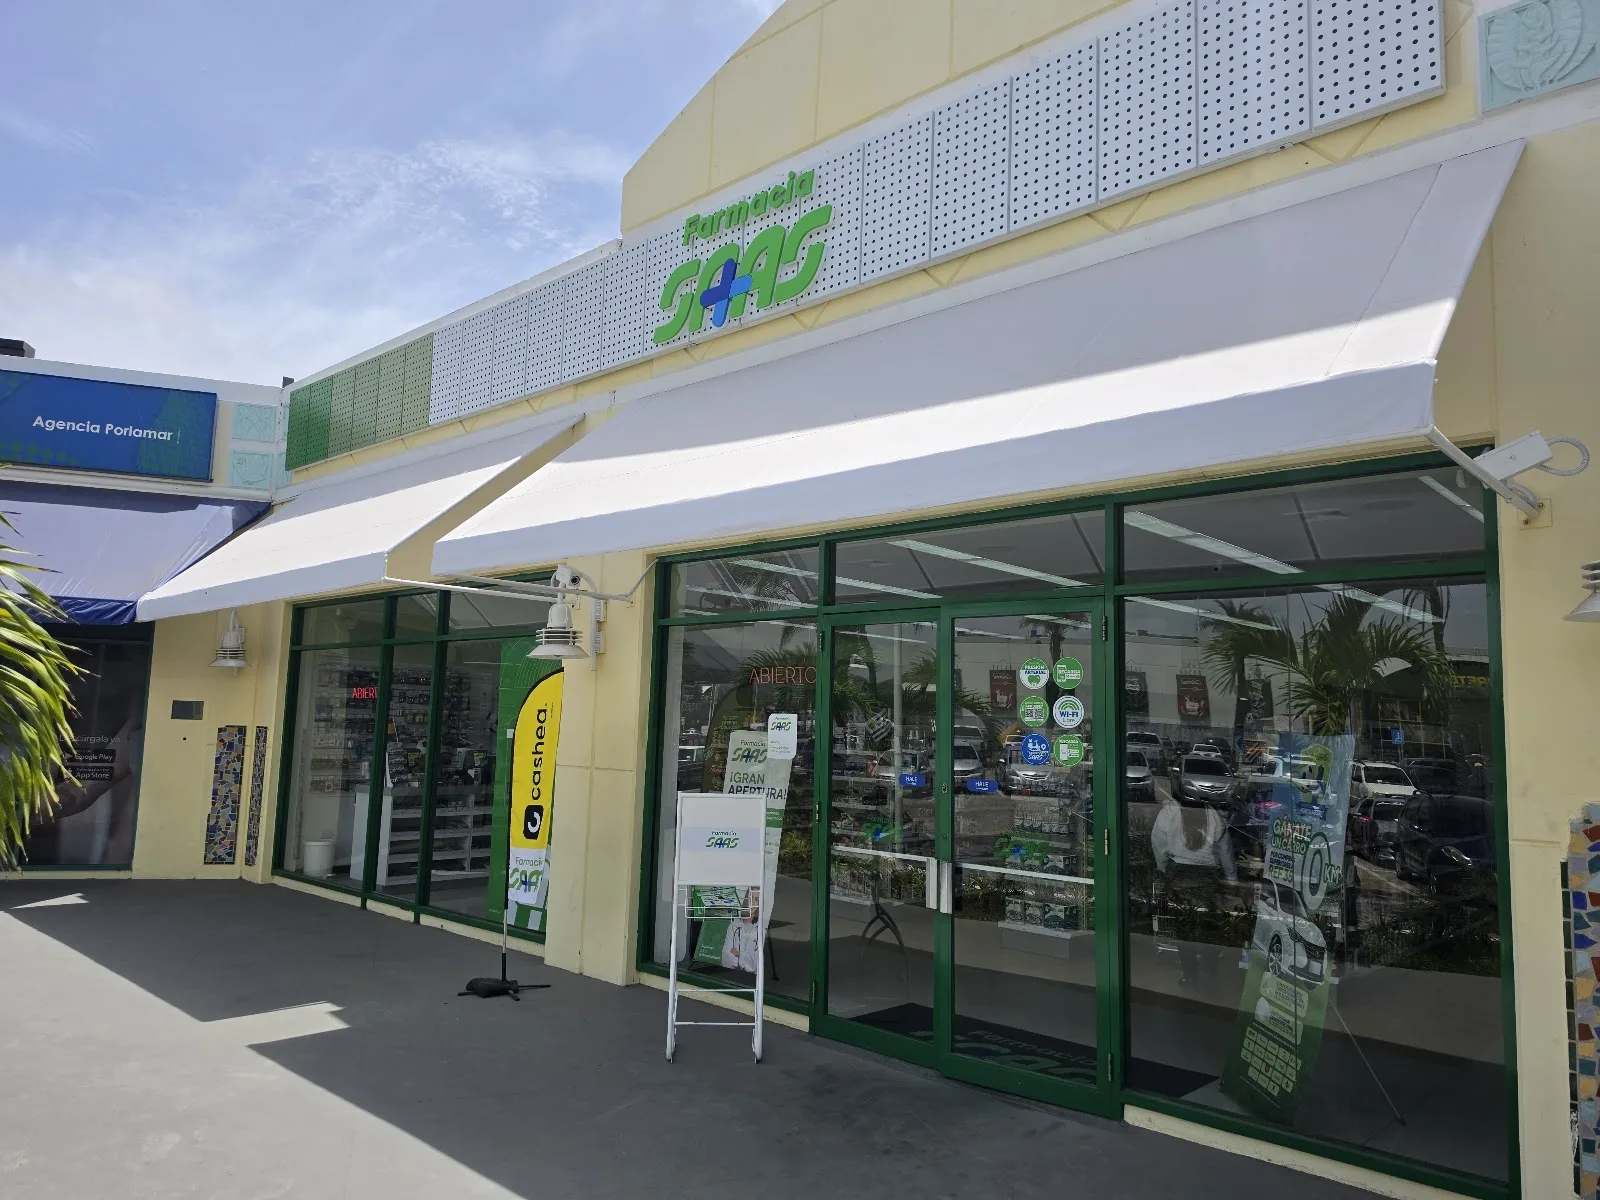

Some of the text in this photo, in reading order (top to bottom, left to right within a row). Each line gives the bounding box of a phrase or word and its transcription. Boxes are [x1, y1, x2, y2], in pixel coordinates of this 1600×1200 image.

[682, 169, 816, 246] Farmacia
[653, 204, 833, 344] SAAS
[32, 415, 101, 434] Agencia
[105, 423, 173, 441] Porlamar
[98, 753, 113, 761] Play
[532, 708, 548, 800] cashea
[75, 771, 90, 779] App
[730, 772, 765, 784] ¡GRAN
